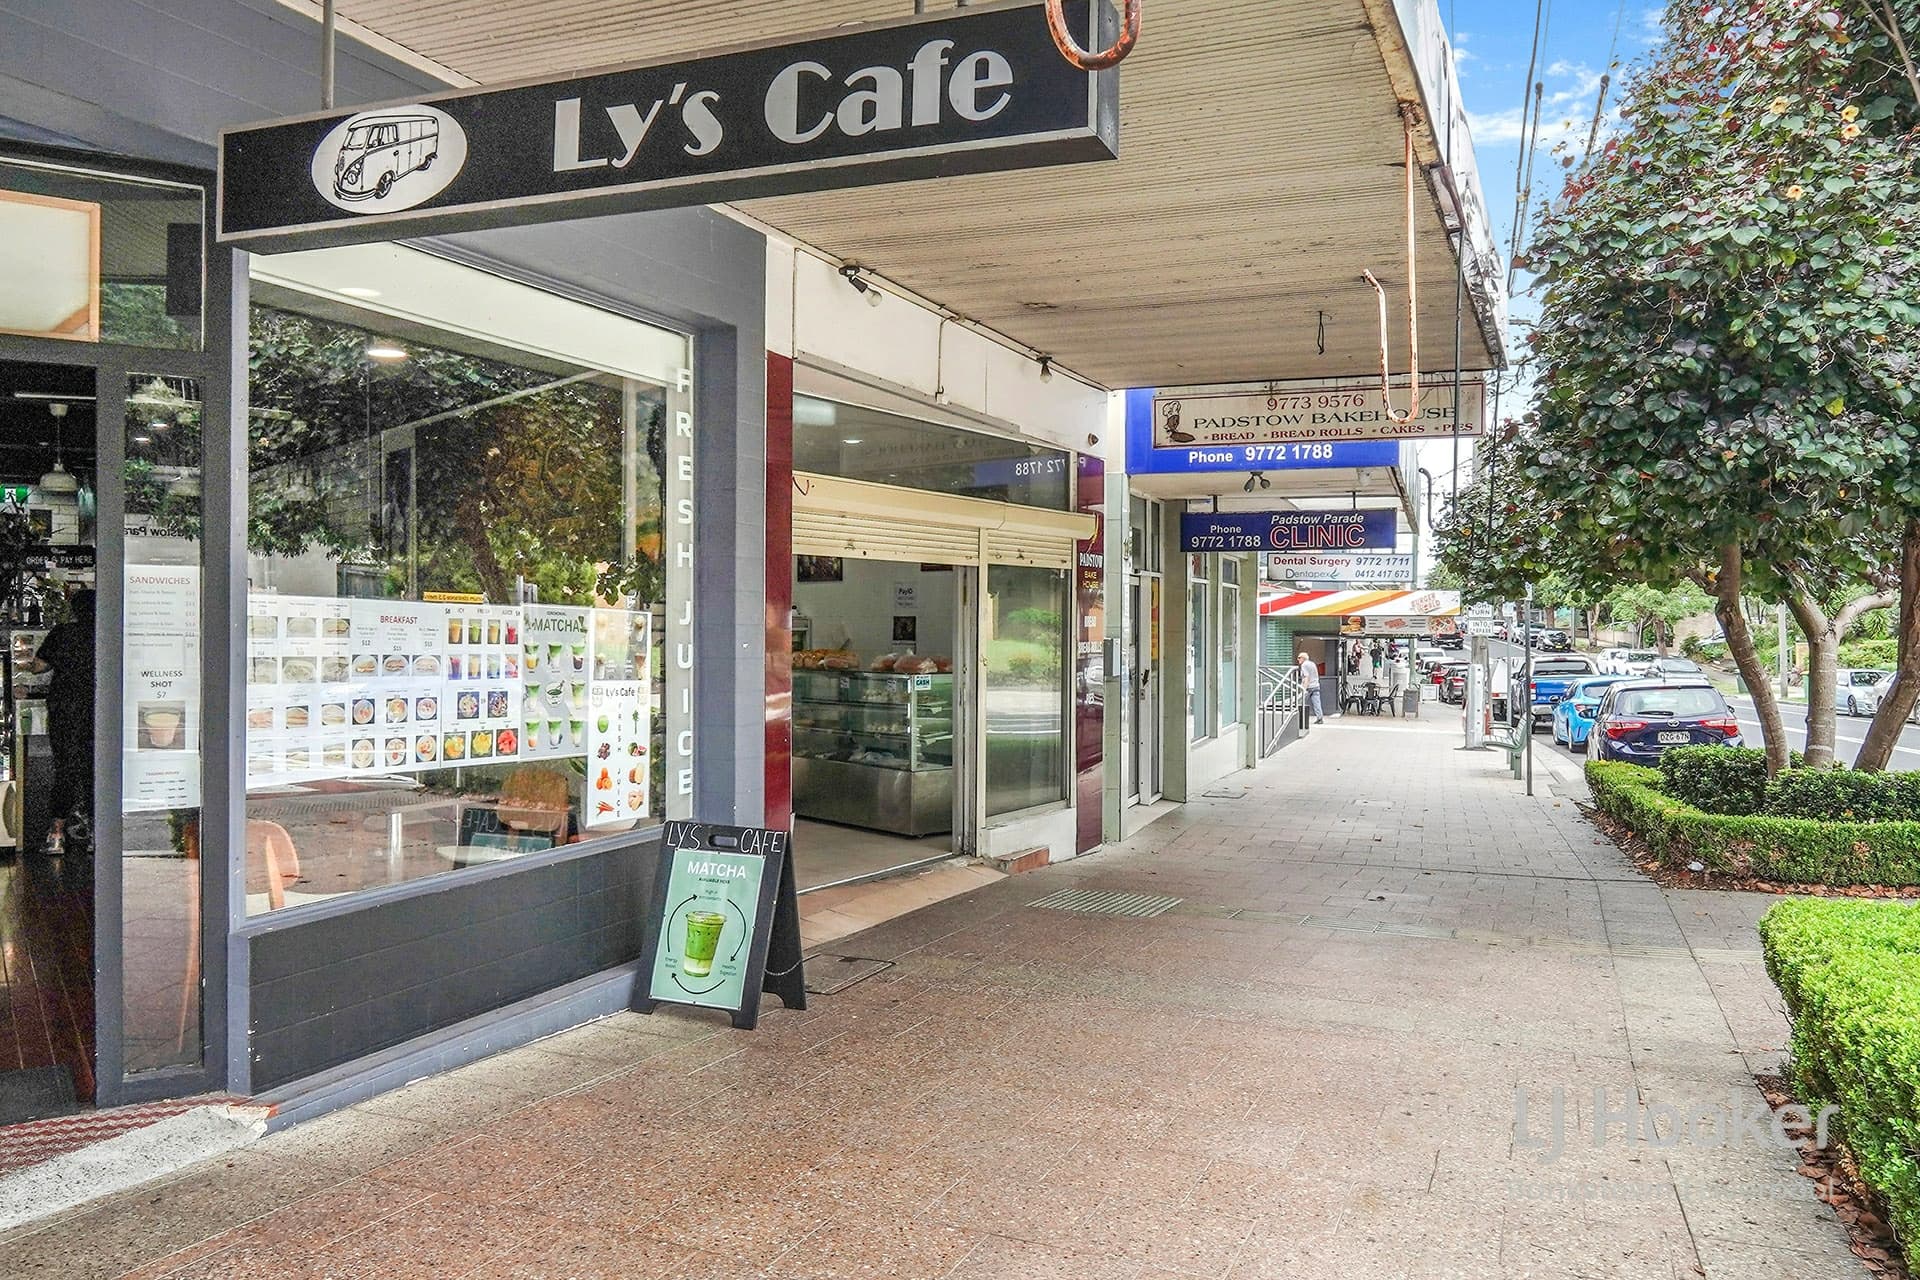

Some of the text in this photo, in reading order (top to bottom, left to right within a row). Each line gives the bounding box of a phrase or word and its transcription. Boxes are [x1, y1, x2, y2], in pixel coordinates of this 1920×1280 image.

[553, 39, 1014, 172] Ly's Cafe
[1267, 394, 1364, 410] 9773 9576
[1194, 413, 1304, 428] PADSTOW
[1212, 432, 1255, 441] BREAD
[1271, 429, 1316, 439] BREAD
[1320, 427, 1363, 437] ROLLS
[1380, 425, 1425, 435] CAKES
[1189, 444, 1333, 463] Phone 9772 1788
[1271, 513, 1364, 525] Padstow Parade
[1210, 525, 1242, 534] Phone
[1270, 524, 1365, 548] CLINIC
[1191, 535, 1261, 548] 9772 1788
[1273, 556, 1410, 567] Dental Surgery 9772 1711
[129, 576, 191, 585] SANDWICHES
[1355, 570, 1376, 578] 0412
[1377, 570, 1392, 578] 417
[1394, 570, 1410, 578] 673
[380, 615, 418, 624] BREAKFAST
[141, 670, 183, 678] WELLNESS
[150, 680, 172, 688] SHOT
[676, 600, 693, 796] JUICE
[740, 828, 784, 856] CAFE
[687, 861, 747, 879] MATCHA
